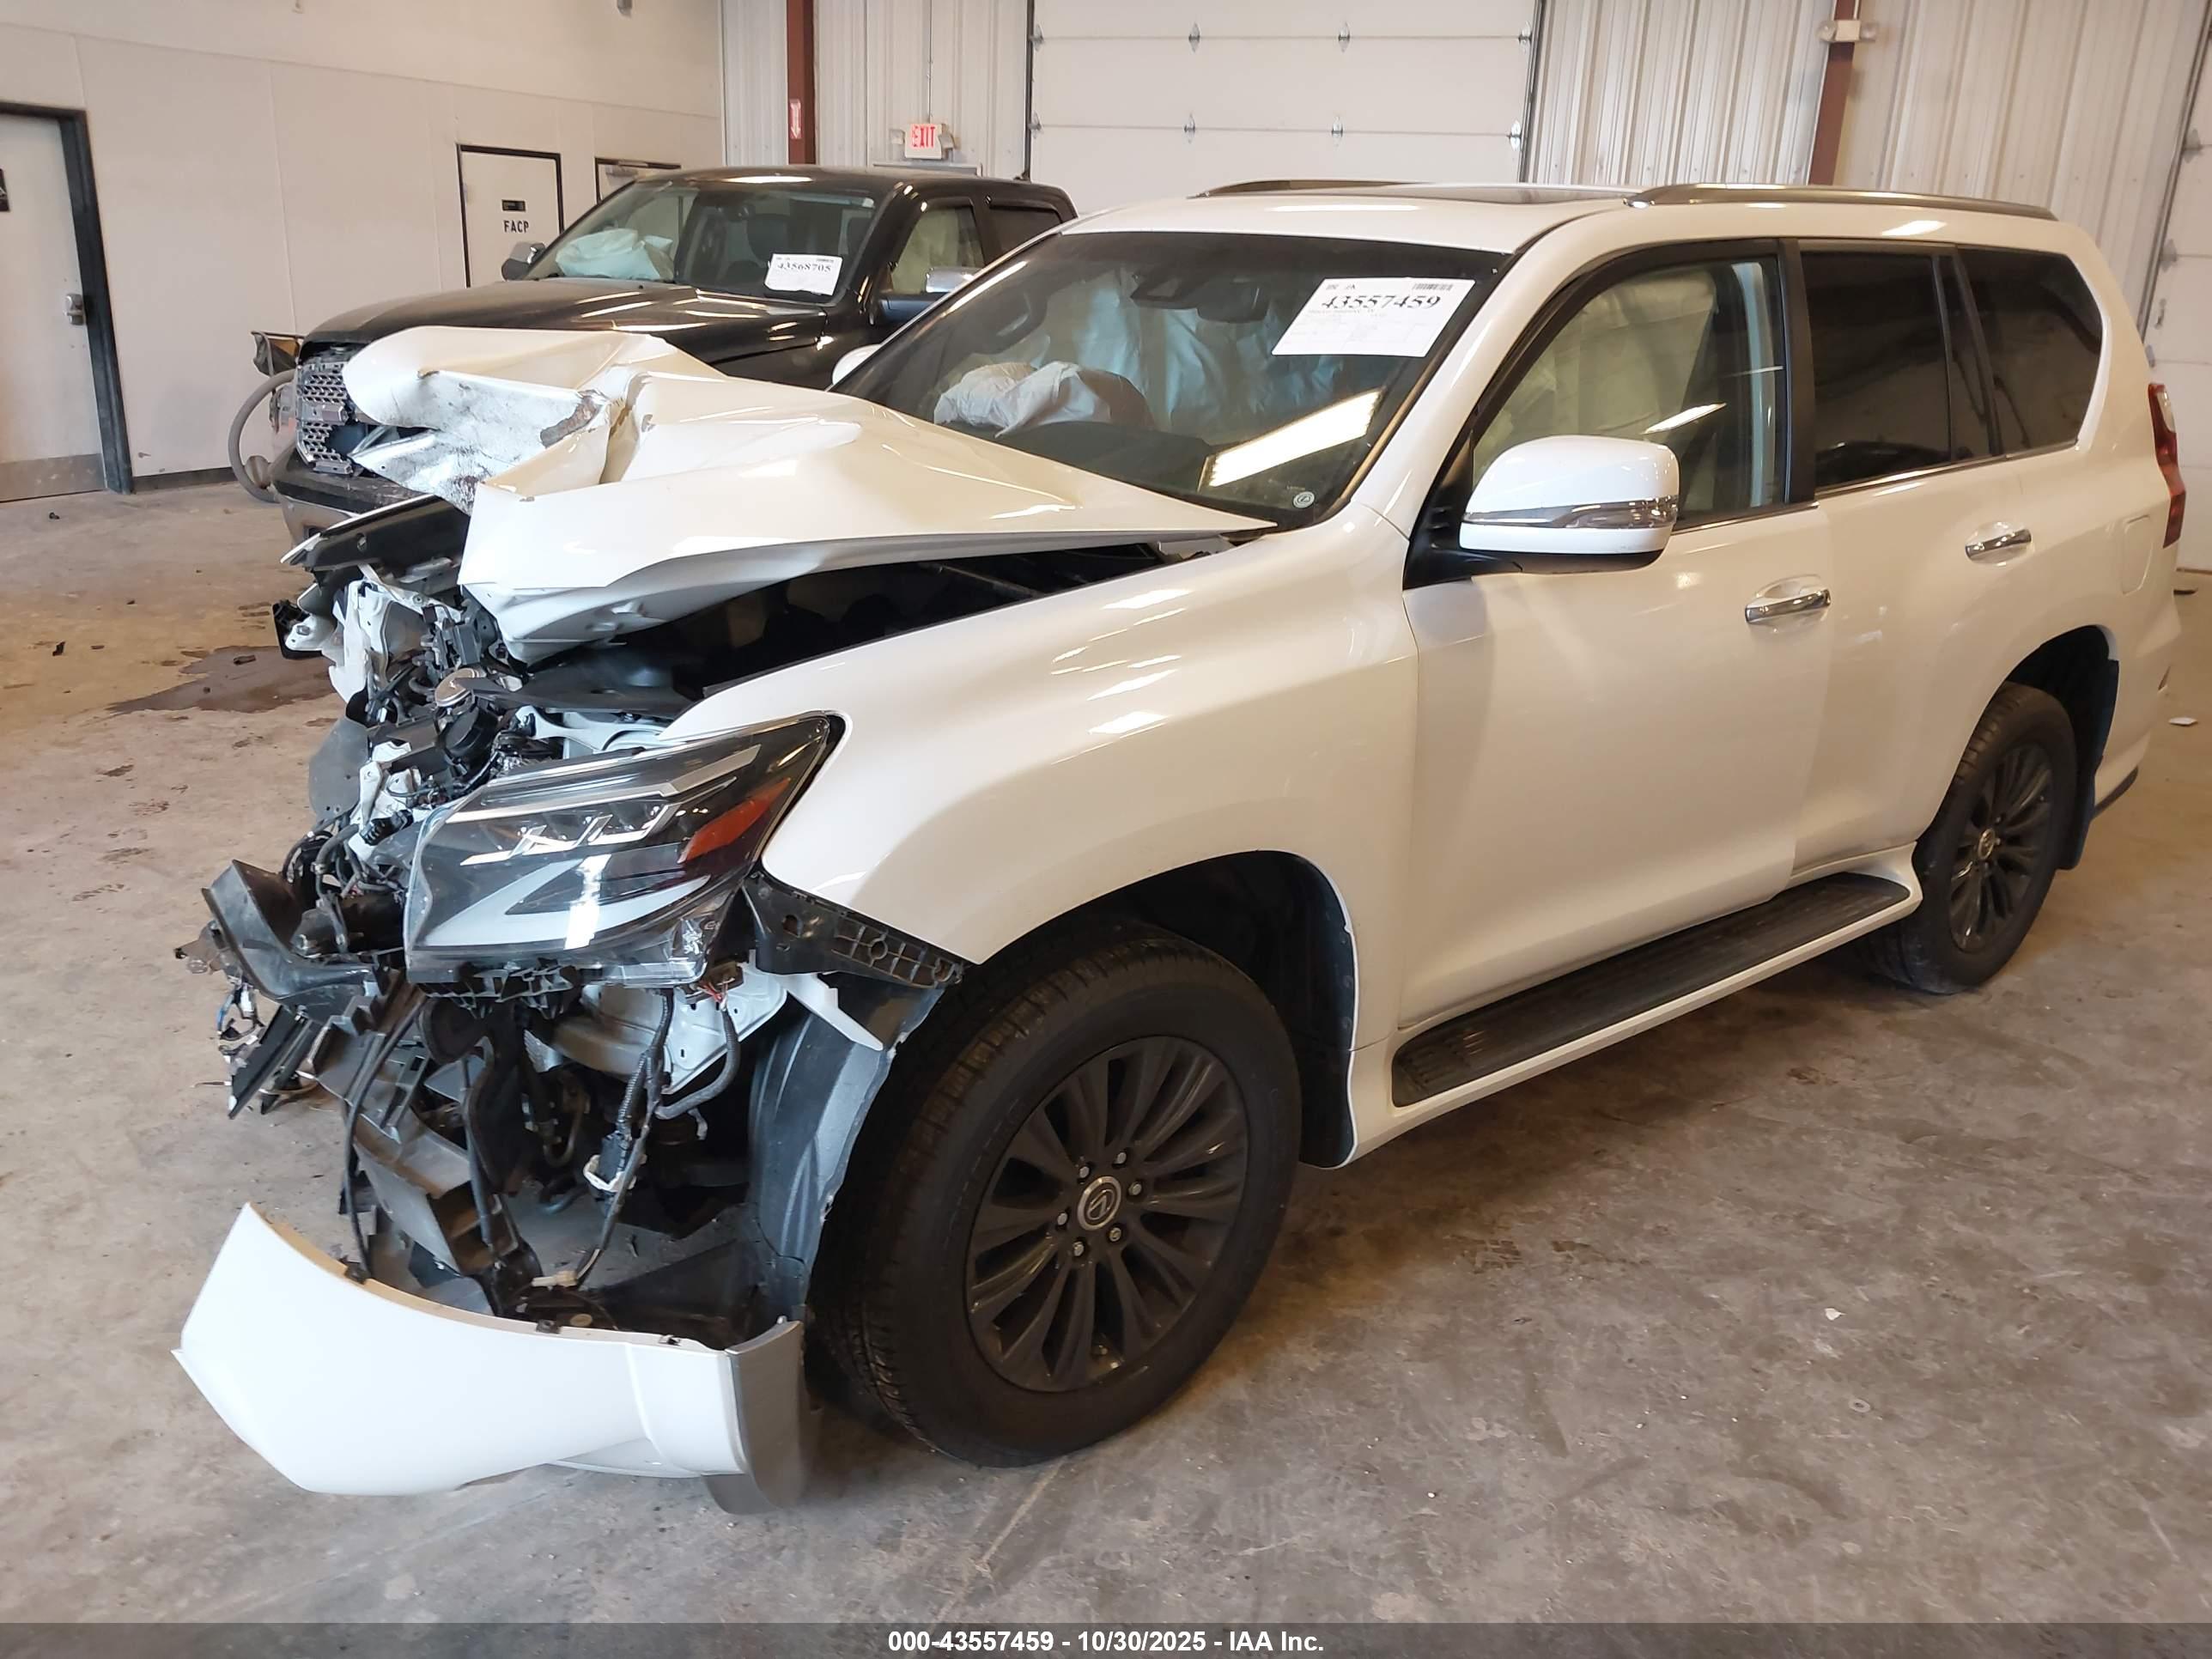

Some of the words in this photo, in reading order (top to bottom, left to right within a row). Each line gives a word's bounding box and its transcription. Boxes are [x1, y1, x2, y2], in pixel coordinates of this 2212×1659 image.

[912, 125, 935, 148] EXIT
[503, 219, 529, 233] FACP
[1321, 295, 1442, 309] 43557459
